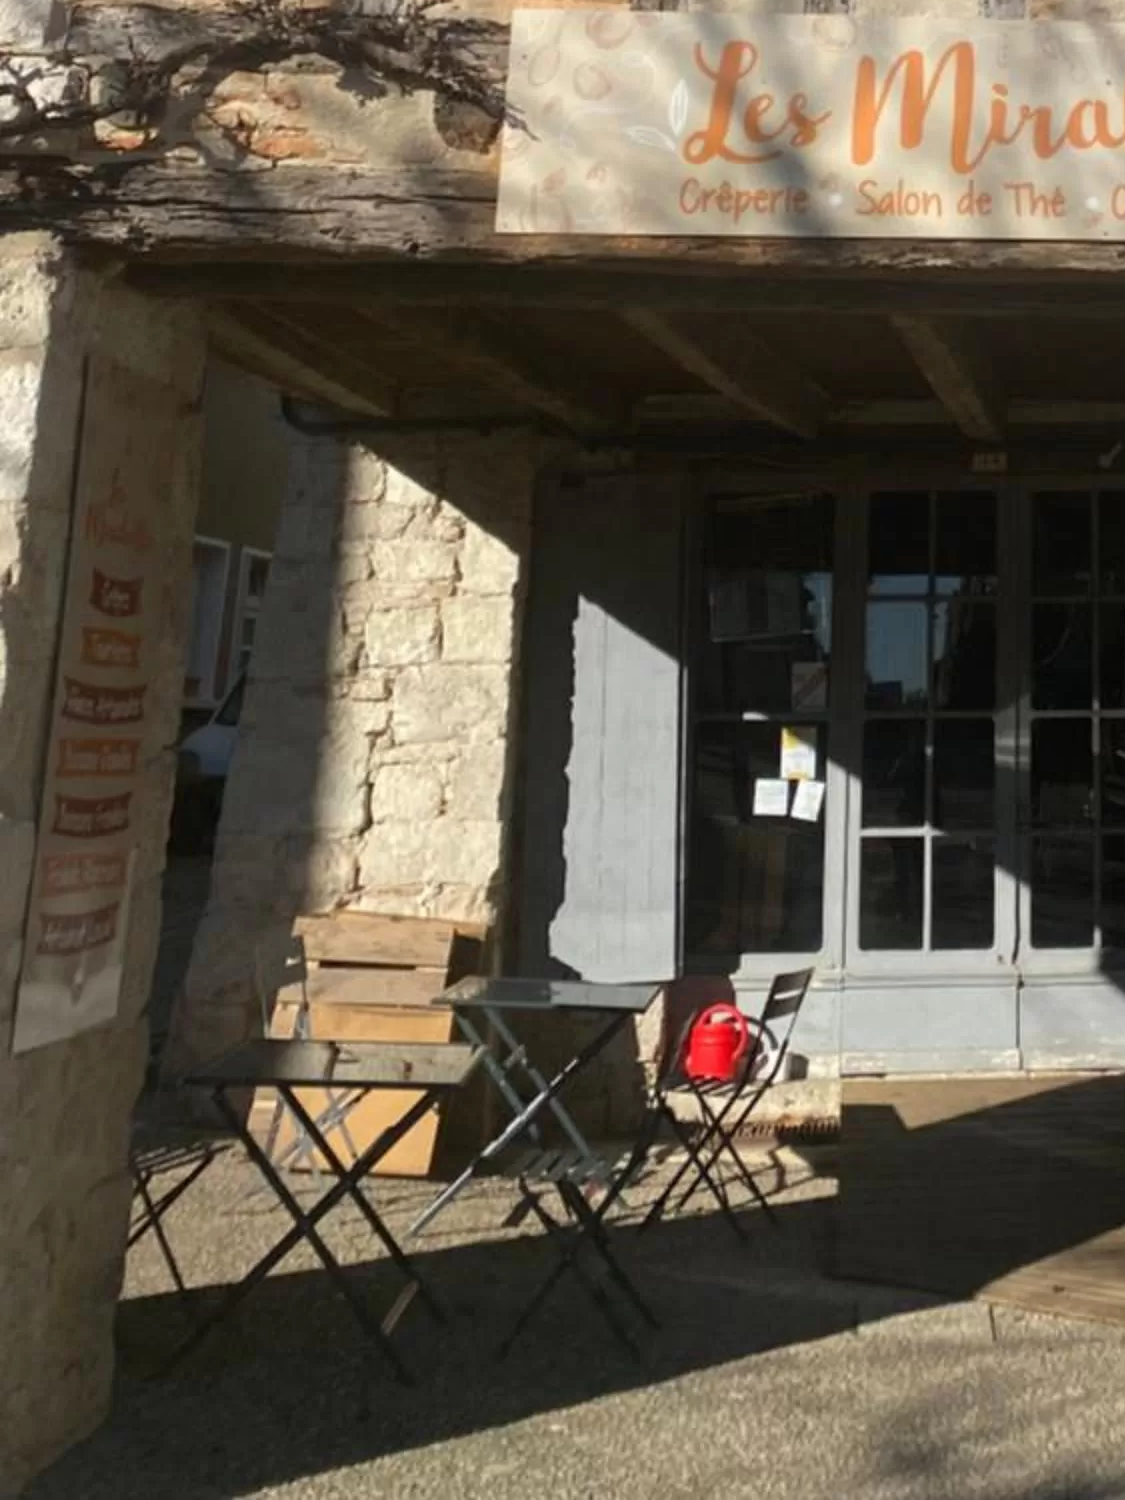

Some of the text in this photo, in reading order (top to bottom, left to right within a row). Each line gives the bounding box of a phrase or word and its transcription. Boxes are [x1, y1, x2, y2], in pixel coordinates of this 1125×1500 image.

[682, 39, 832, 165] Les
[678, 177, 810, 223] Crêperie
[855, 179, 944, 218] Salon
[956, 180, 992, 218] de
[1003, 181, 1067, 219] Thé
